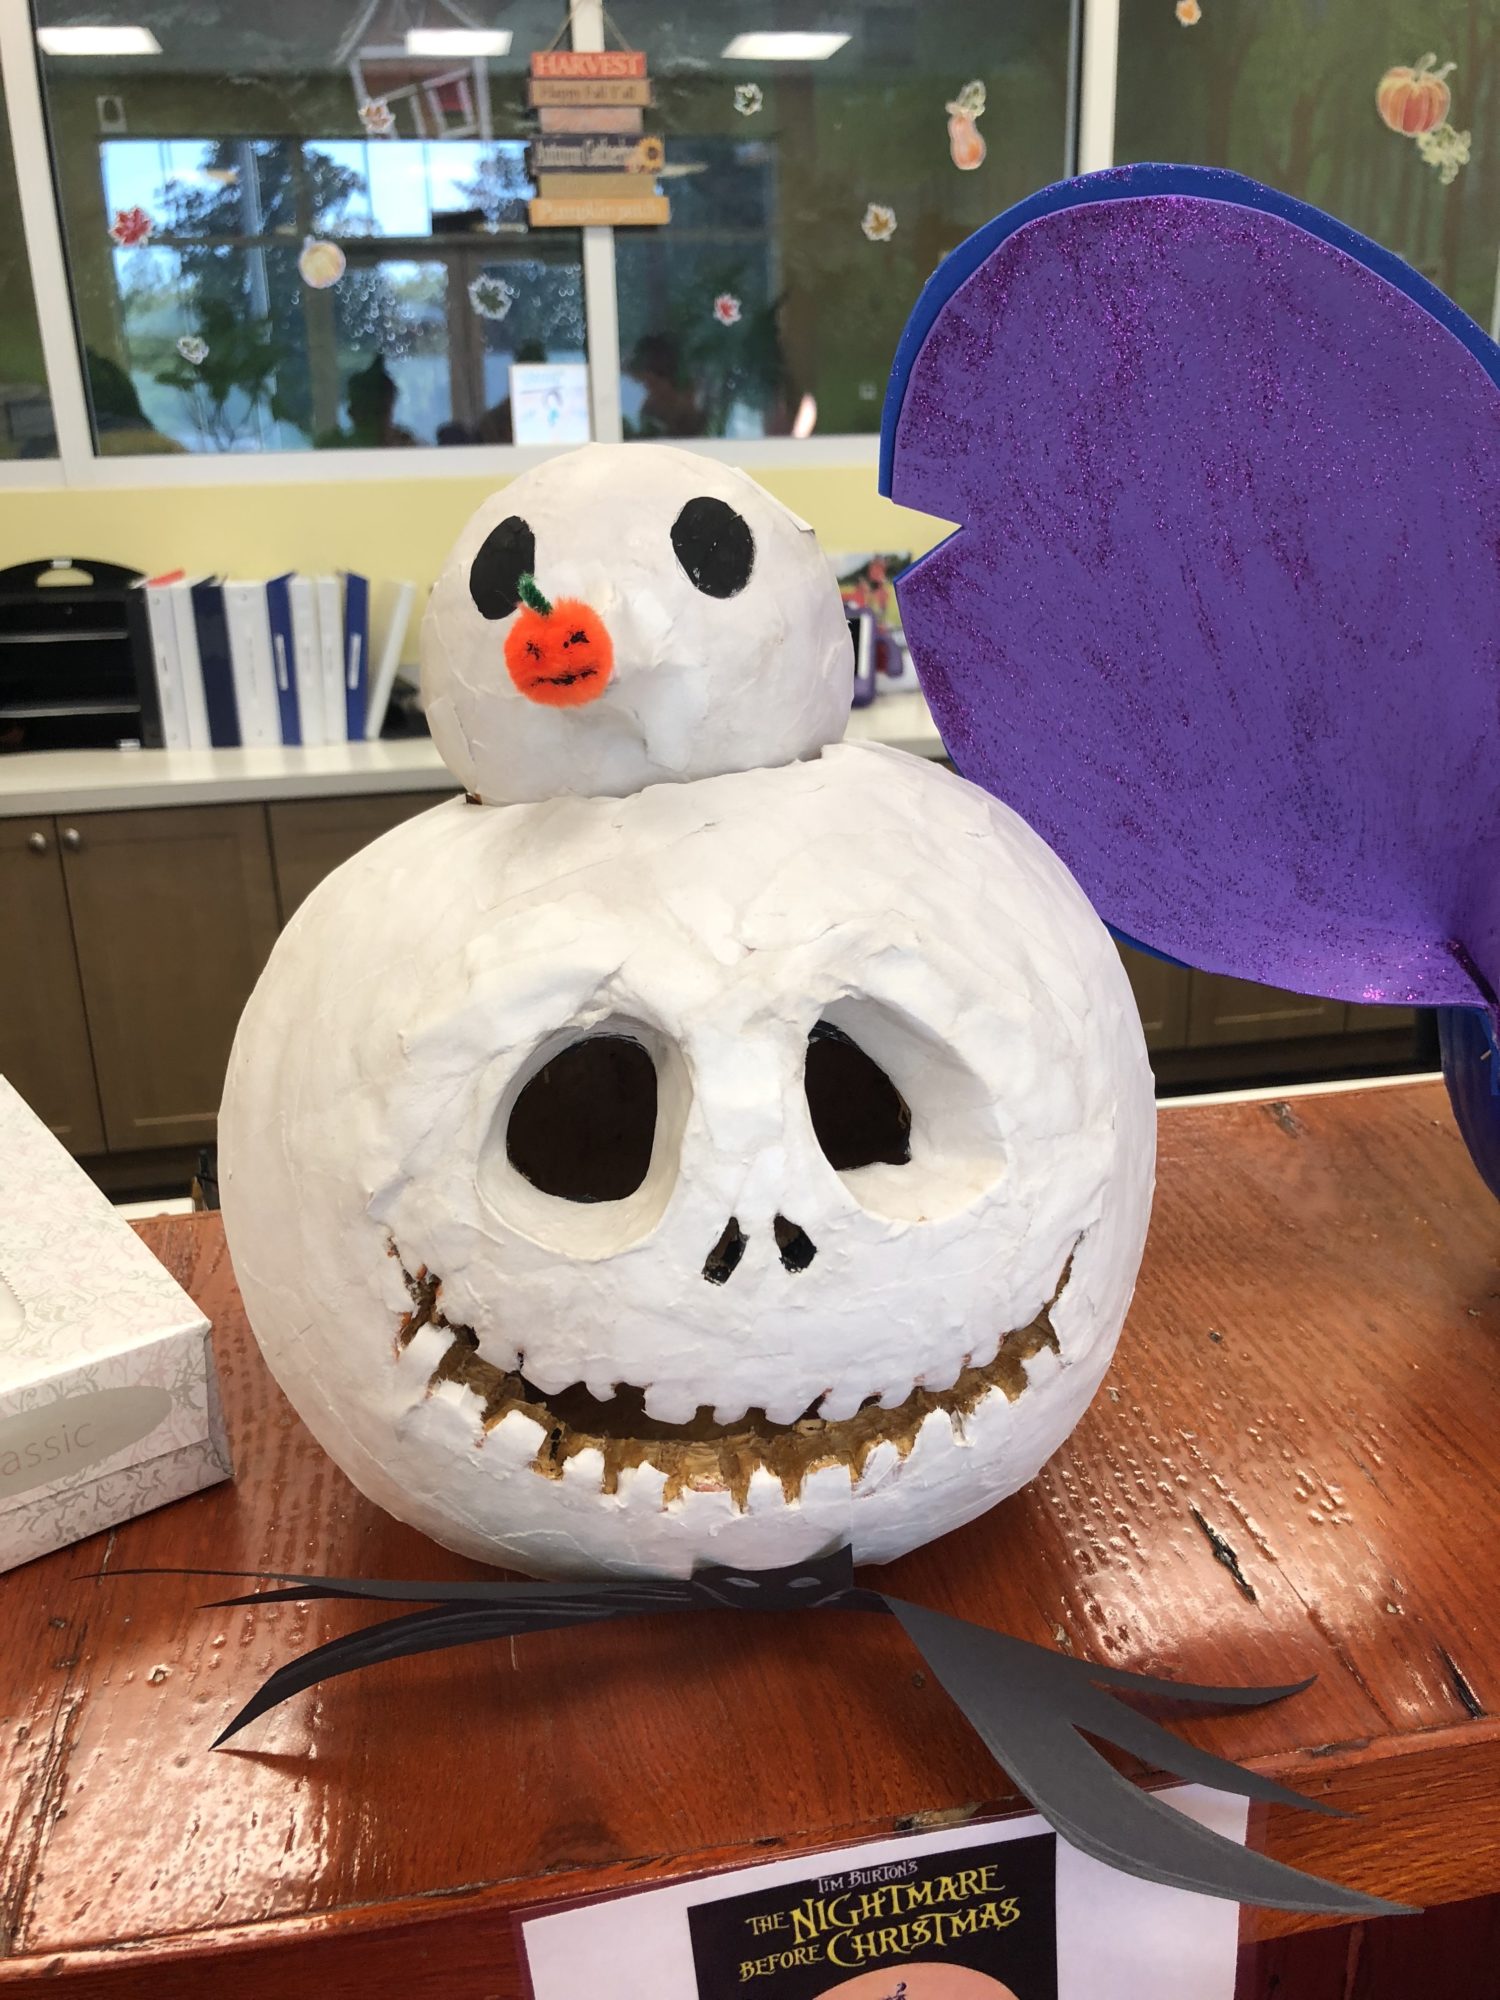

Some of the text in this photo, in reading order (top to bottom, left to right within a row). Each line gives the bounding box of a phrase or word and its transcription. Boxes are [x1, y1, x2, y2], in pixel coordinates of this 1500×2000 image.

[535, 54, 641, 76] HARVEST
[0, 1422, 97, 1476] assic
[812, 1860, 918, 1894] TIM BURTON'S
[745, 1865, 1006, 1944] THE NIGHTMARE
[739, 1897, 1021, 1982] BEFORE CHRISTMAS
